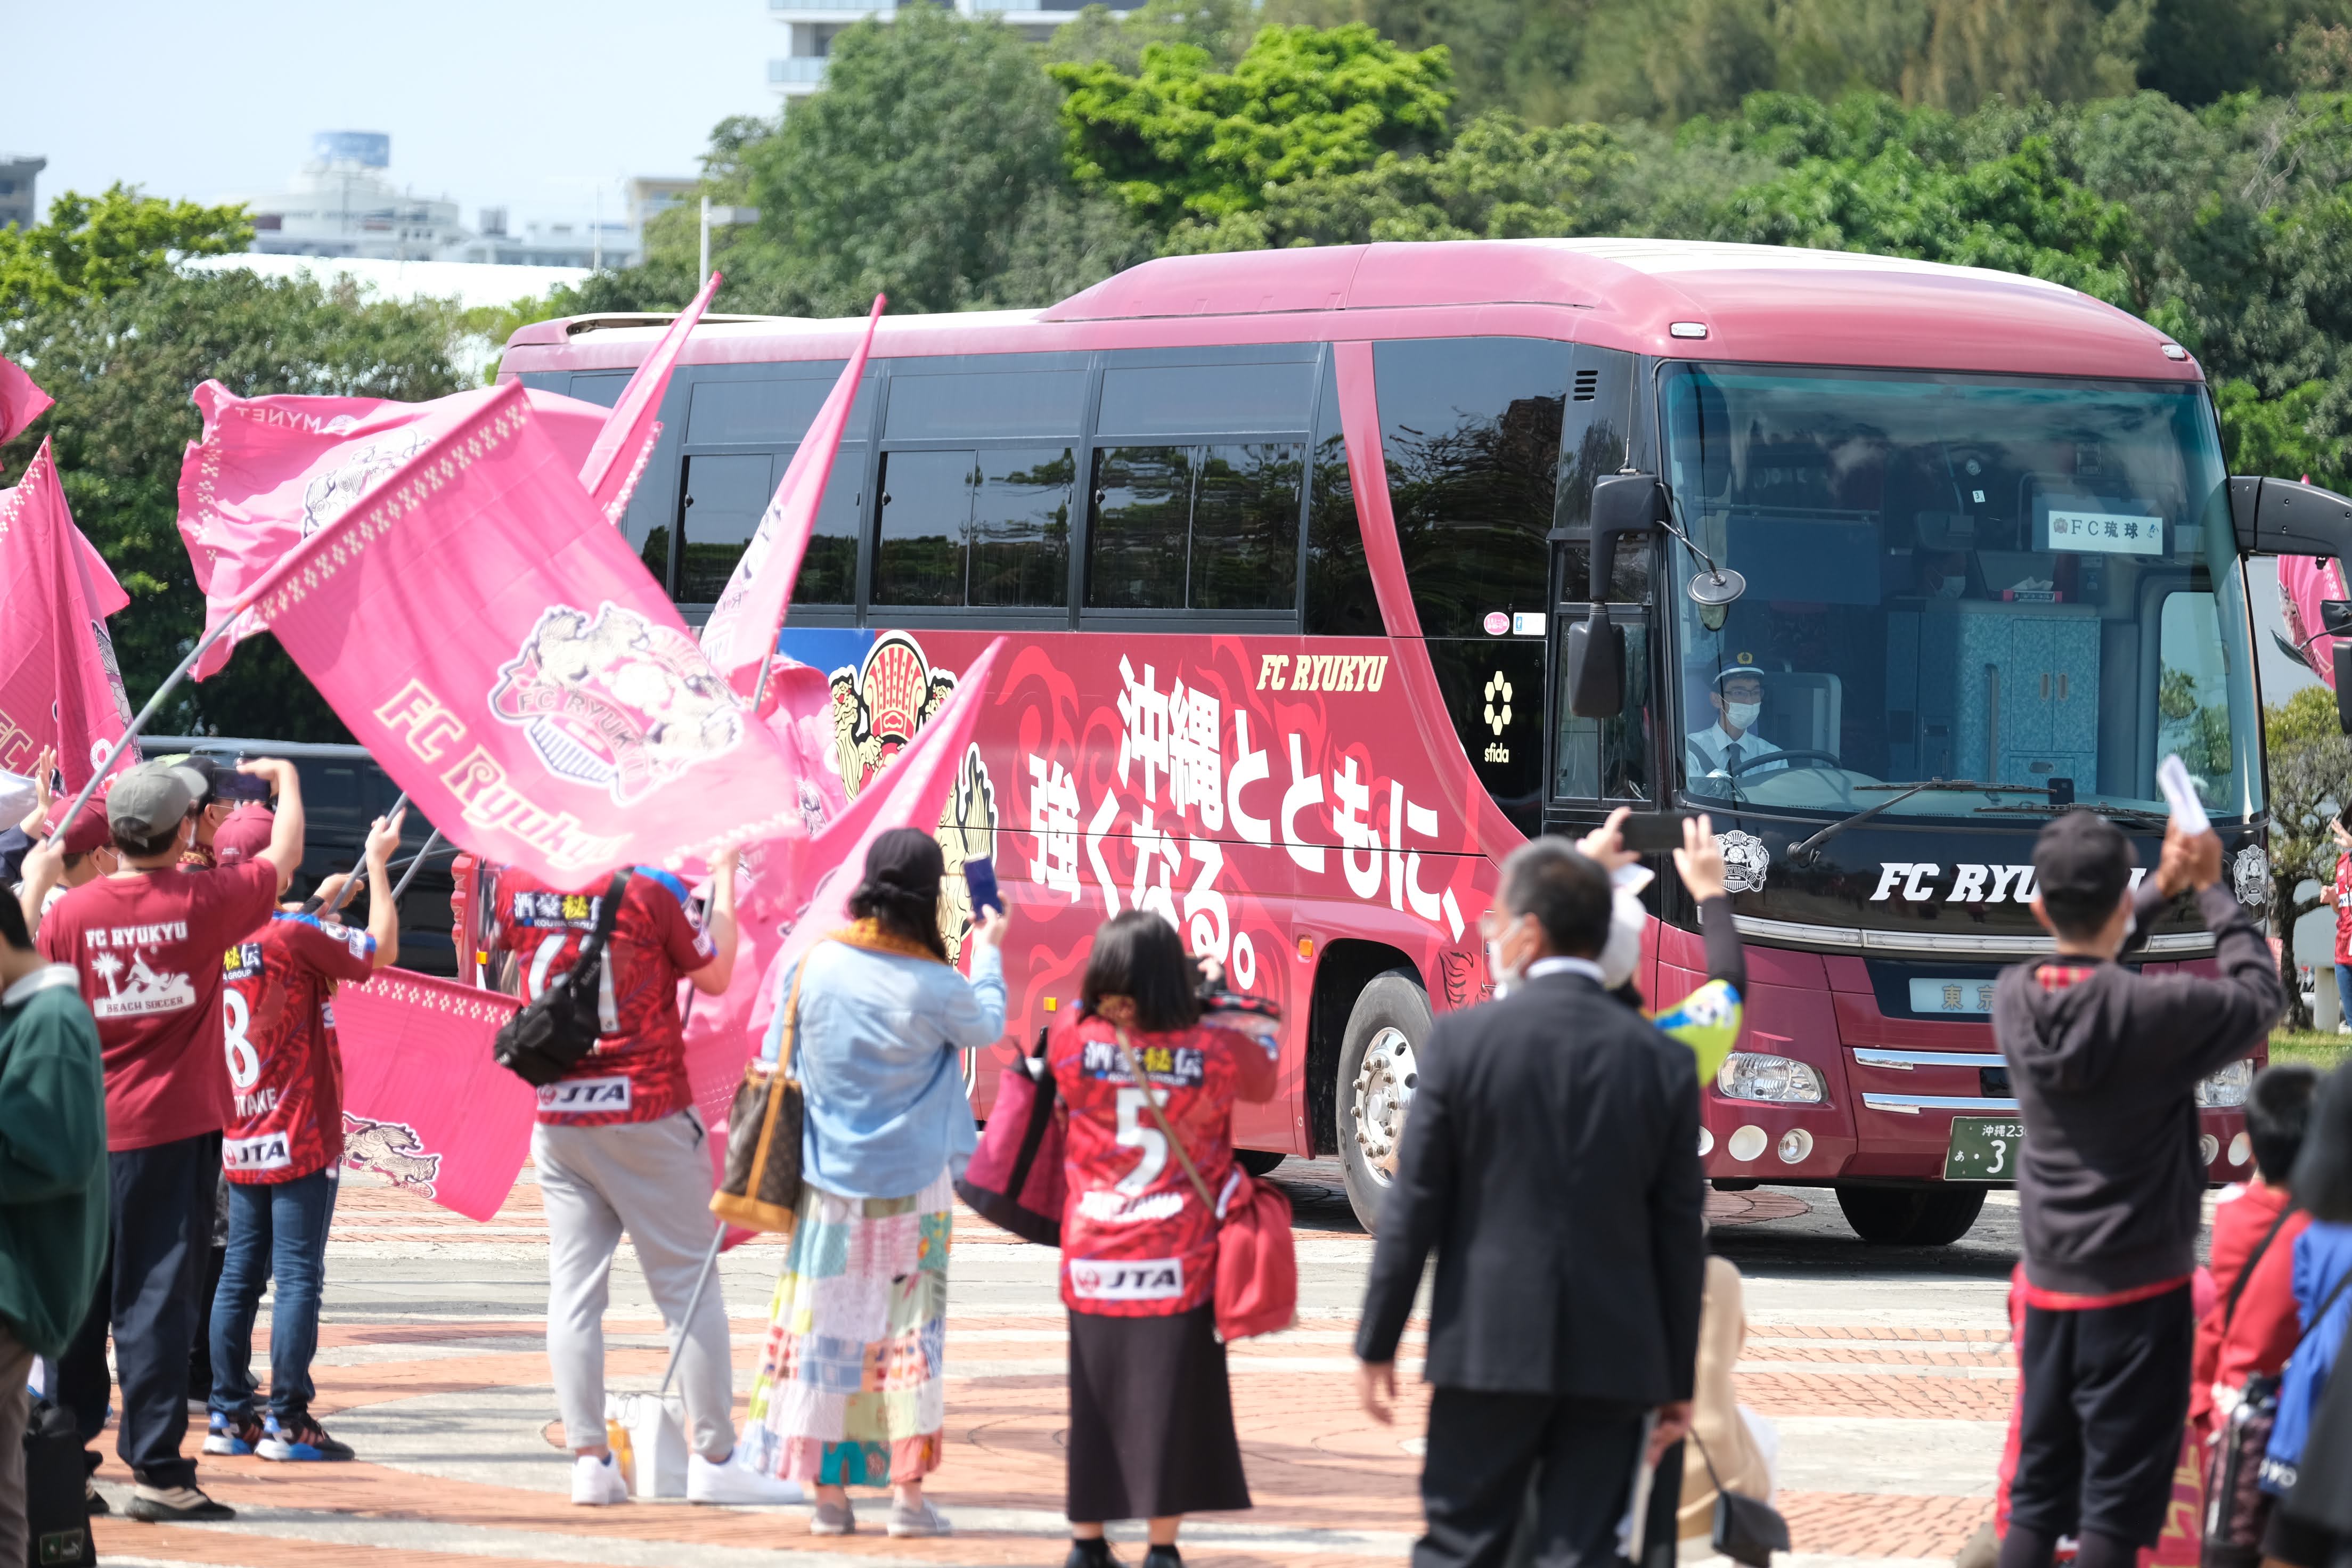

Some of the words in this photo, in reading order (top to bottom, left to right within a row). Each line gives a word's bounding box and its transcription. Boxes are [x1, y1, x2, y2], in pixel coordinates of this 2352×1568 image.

[2071, 519, 2138, 539] FC琉球
[1255, 655, 1289, 690] FC
[1290, 655, 1389, 692] RYUKYU
[373, 678, 467, 763] FC
[1484, 742, 1509, 763] sfida
[1117, 653, 1465, 944] 沖縄とともに、
[1029, 753, 1255, 990] 強くなる。
[1869, 863, 1940, 901] FC
[85, 929, 107, 948] FC
[111, 921, 187, 945] RYUKYU
[567, 920, 598, 930] GROU
[228, 969, 252, 979] GROUP
[107, 1001, 142, 1012] BEACH
[145, 996, 184, 1009] SOCCER
[223, 988, 260, 1088] 8
[560, 1084, 625, 1103] JTA
[240, 1140, 285, 1163] JTA
[1115, 1088, 1169, 1196] 5
[1954, 1150, 1965, 1162] あ
[1107, 1268, 1176, 1289] JTA
